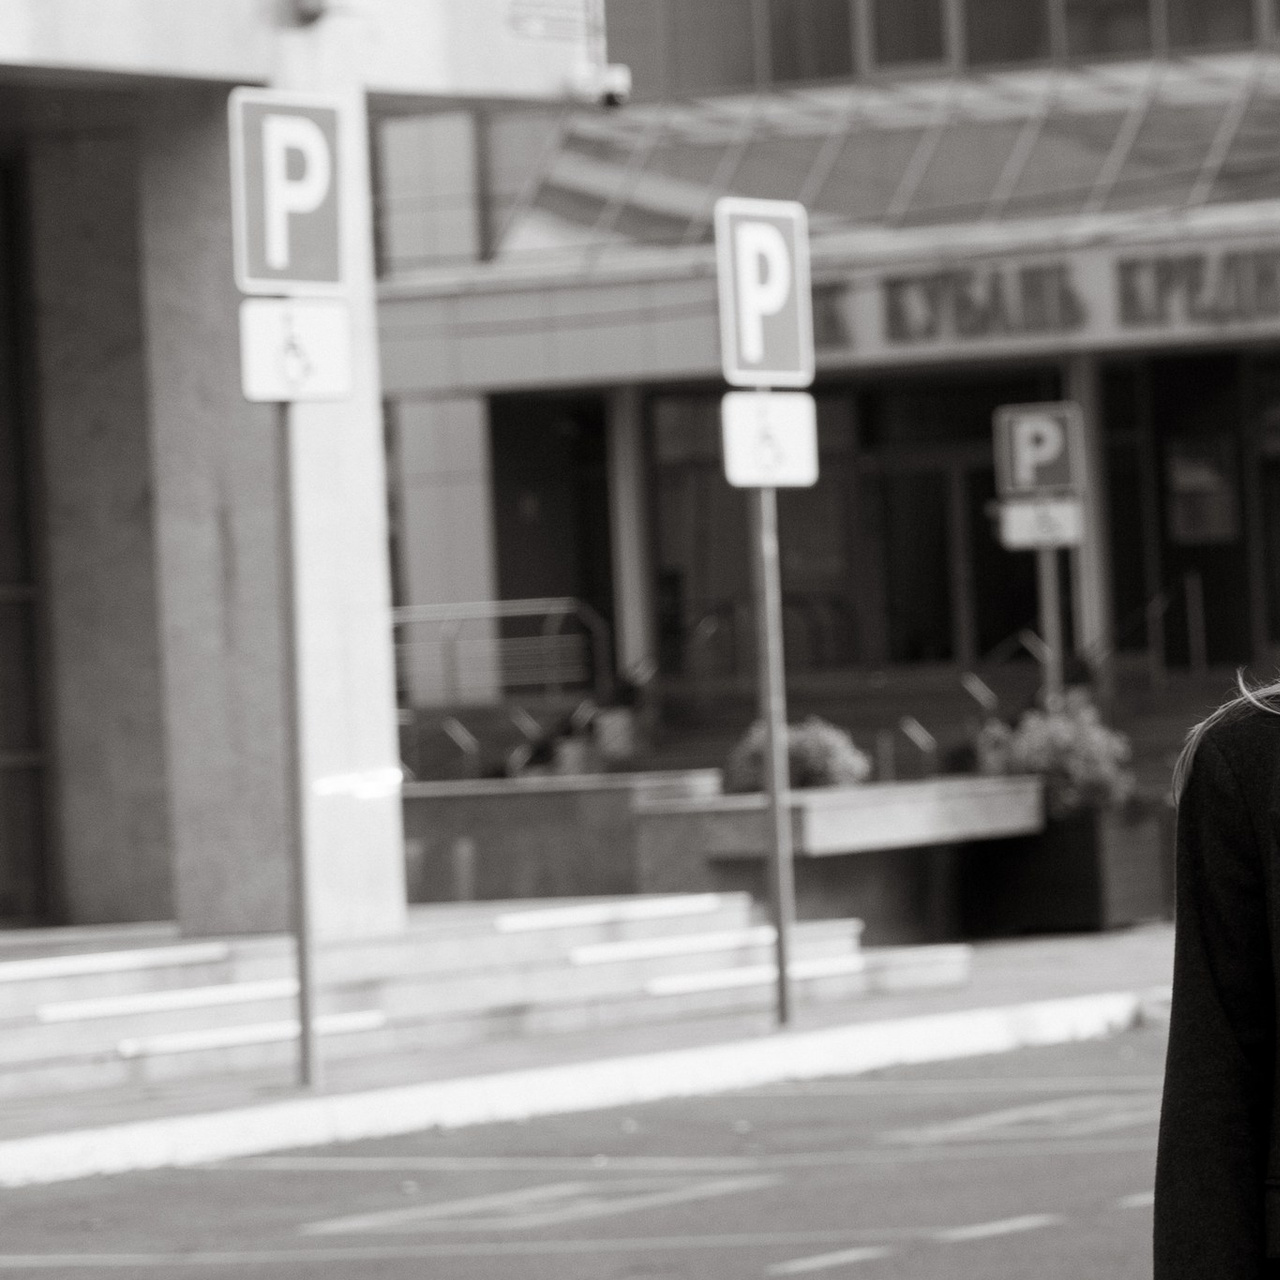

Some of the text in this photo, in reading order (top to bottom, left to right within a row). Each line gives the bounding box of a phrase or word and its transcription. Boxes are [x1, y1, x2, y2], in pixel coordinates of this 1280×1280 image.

[263, 115, 331, 269] P
[735, 222, 791, 363] P
[1013, 414, 1064, 488] P
